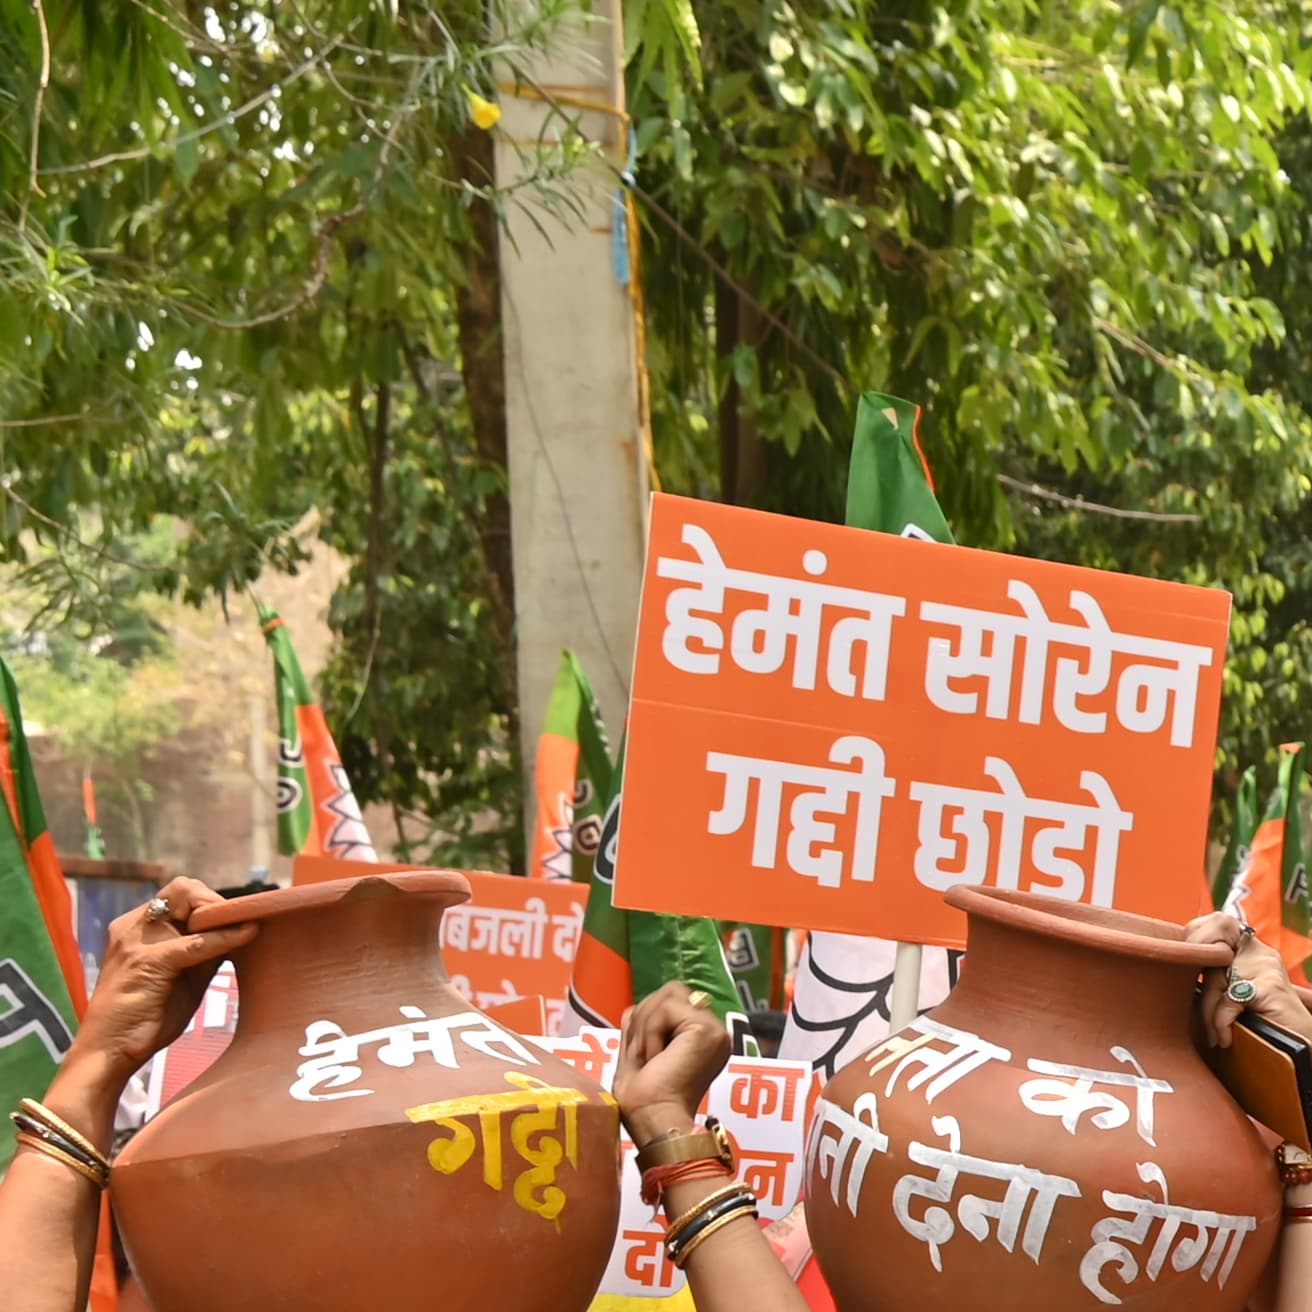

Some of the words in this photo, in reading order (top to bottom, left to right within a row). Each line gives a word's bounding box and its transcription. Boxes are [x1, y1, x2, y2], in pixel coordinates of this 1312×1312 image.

[657, 524, 905, 701] हेमंत
[920, 580, 1213, 748] सोरेन
[706, 735, 896, 888] गद्दी
[728, 1063, 805, 1122] का
[1019, 1045, 1174, 1147] को
[892, 1115, 1082, 1273] देना
[1079, 1161, 1257, 1305] होगा
